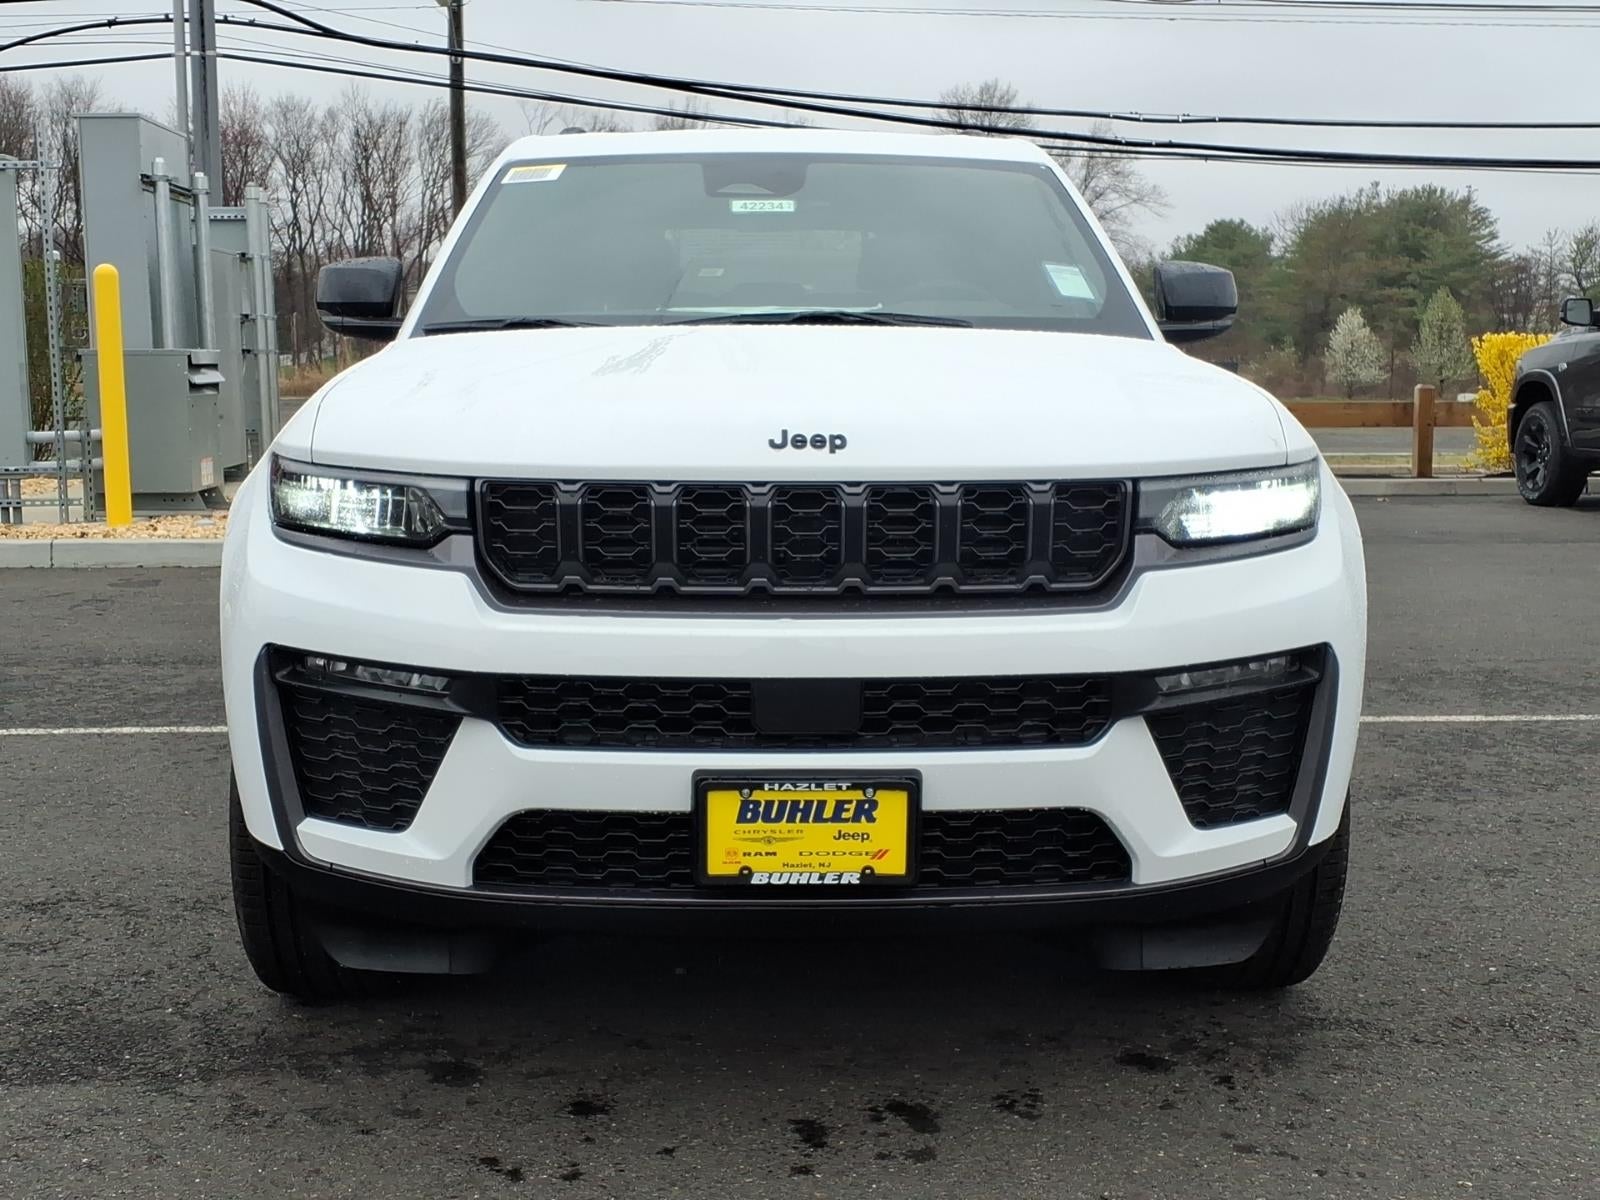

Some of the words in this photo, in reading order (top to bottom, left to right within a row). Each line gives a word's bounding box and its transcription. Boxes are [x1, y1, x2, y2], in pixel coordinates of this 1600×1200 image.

[768, 429, 847, 454] Jeep
[764, 783, 852, 791] HAZLET
[736, 799, 879, 824] BUHLER
[833, 829, 871, 843] Jeep
[750, 872, 861, 885] BUHLER
